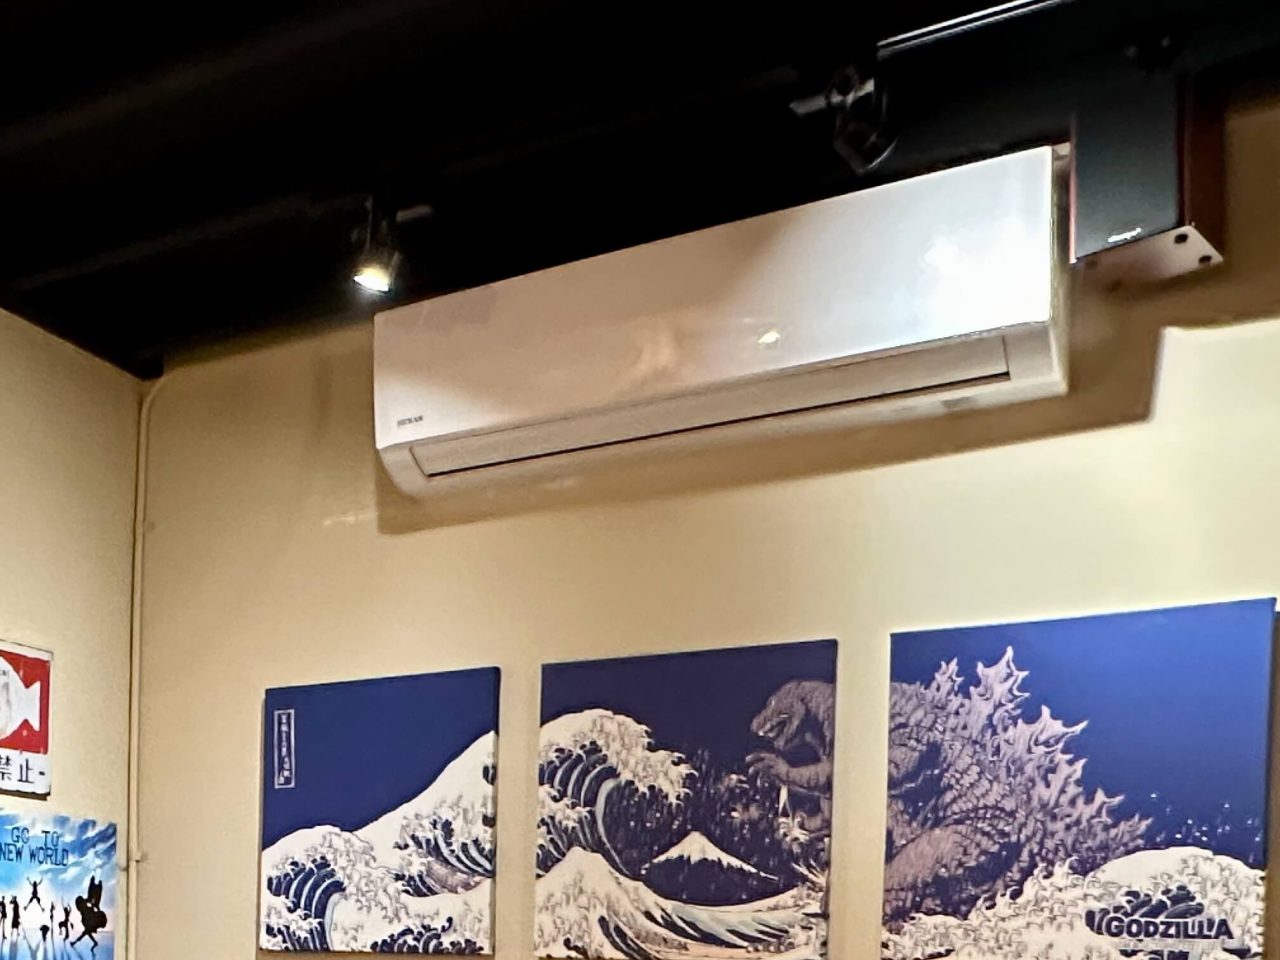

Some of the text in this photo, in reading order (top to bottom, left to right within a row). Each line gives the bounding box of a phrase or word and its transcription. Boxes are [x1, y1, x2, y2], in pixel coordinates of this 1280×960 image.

[11, 827, 60, 848] GO TO
[29, 846, 69, 867] WORLD
[1104, 916, 1234, 939] GODZILLA
